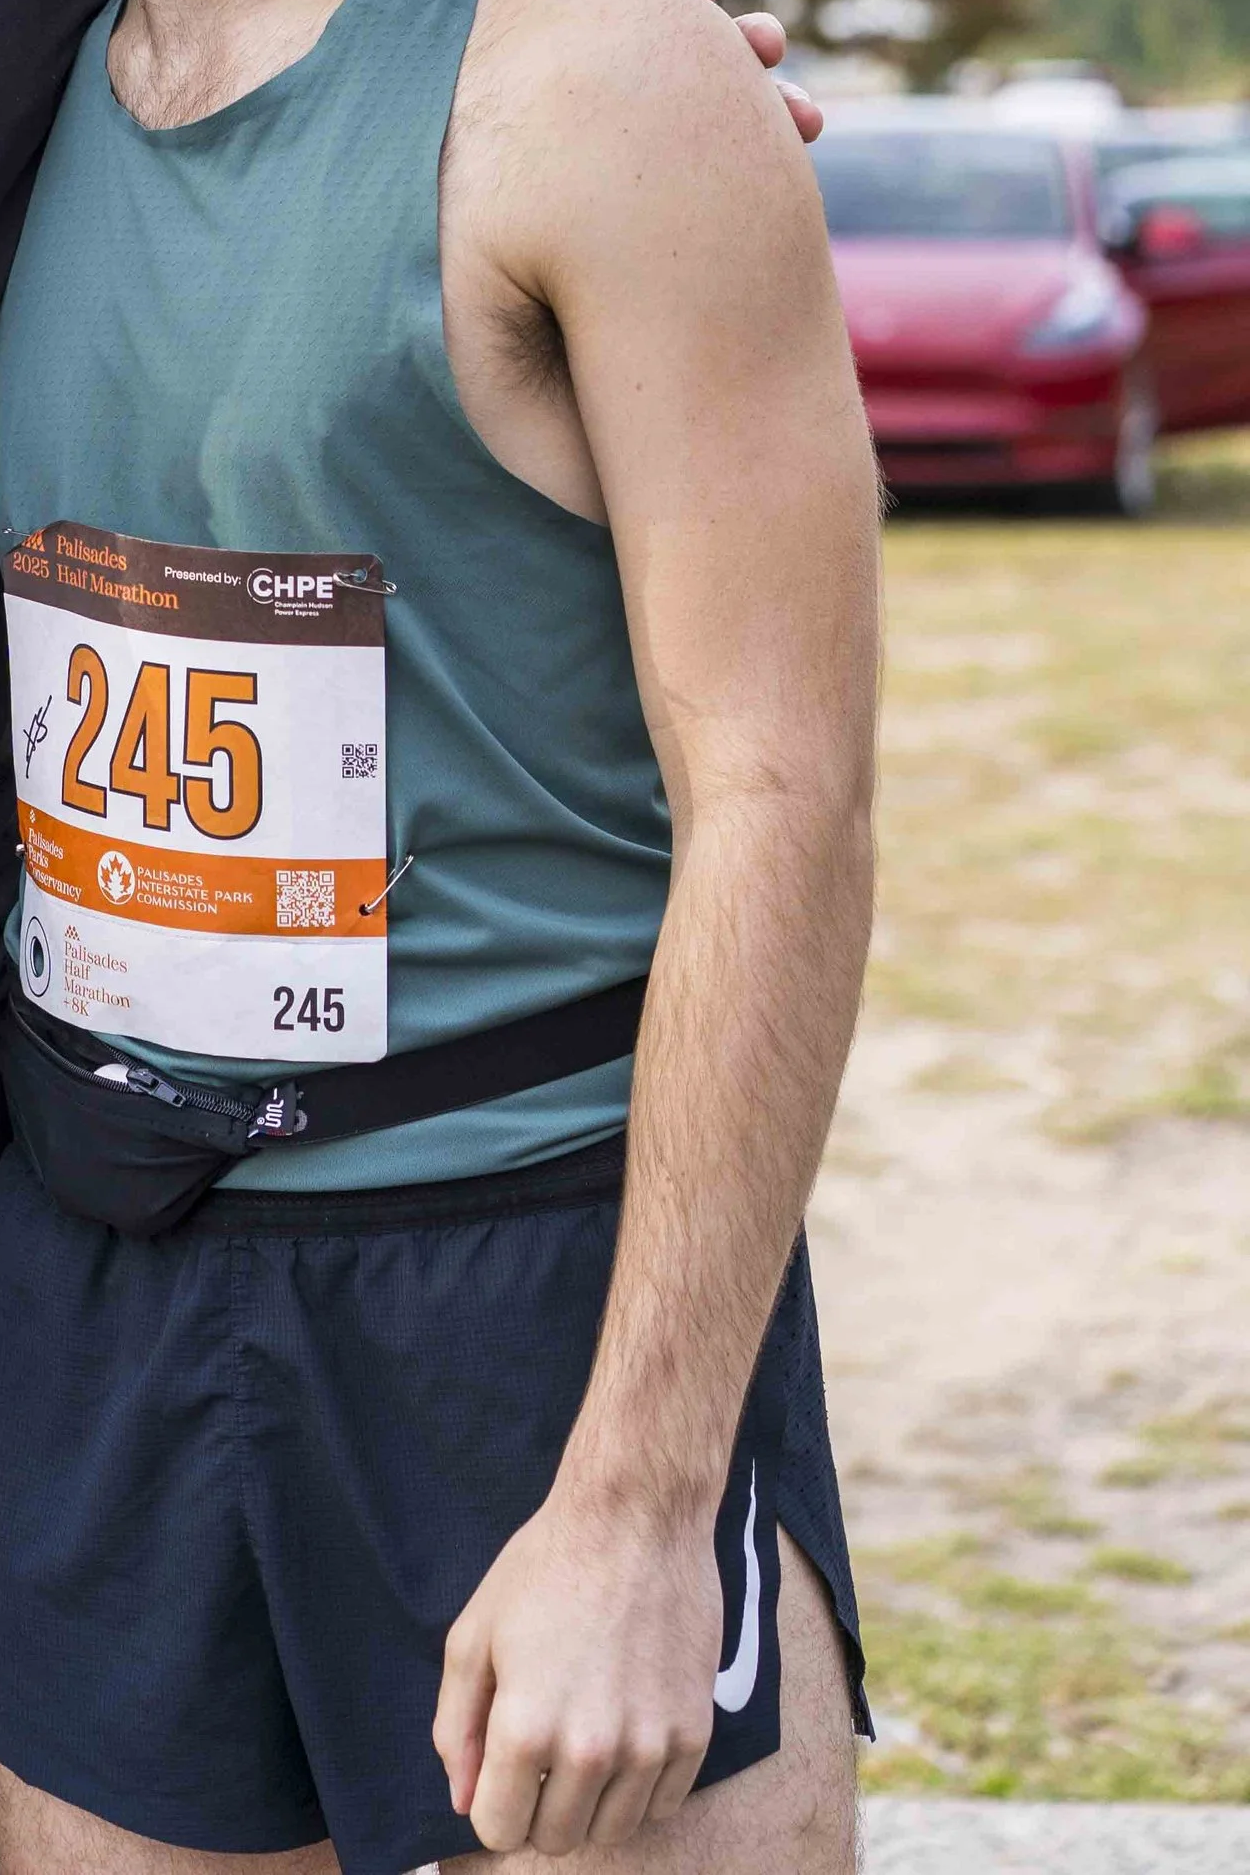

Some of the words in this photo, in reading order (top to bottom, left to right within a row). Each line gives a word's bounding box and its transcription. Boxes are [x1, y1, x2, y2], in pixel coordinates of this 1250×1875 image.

[13, 552, 49, 578] 2025
[56, 534, 127, 571] Palisades
[56, 564, 87, 590] Half
[90, 574, 179, 609] Marathon
[164, 566, 221, 585] Presented
[223, 572, 242, 587] by:
[252, 574, 333, 598] CHPE
[62, 643, 263, 841] 245
[27, 843, 49, 868] Parks
[28, 827, 64, 859] Palisades
[137, 866, 203, 886] PALISADES
[136, 893, 218, 914] COMMISSION
[137, 879, 209, 900] INTERSTATE
[215, 890, 253, 903] PARK
[64, 941, 128, 973] Palisades
[64, 959, 90, 980] Half
[63, 977, 131, 1008] Marathon
[63, 996, 89, 1016] +8K
[274, 986, 344, 1032] 245
